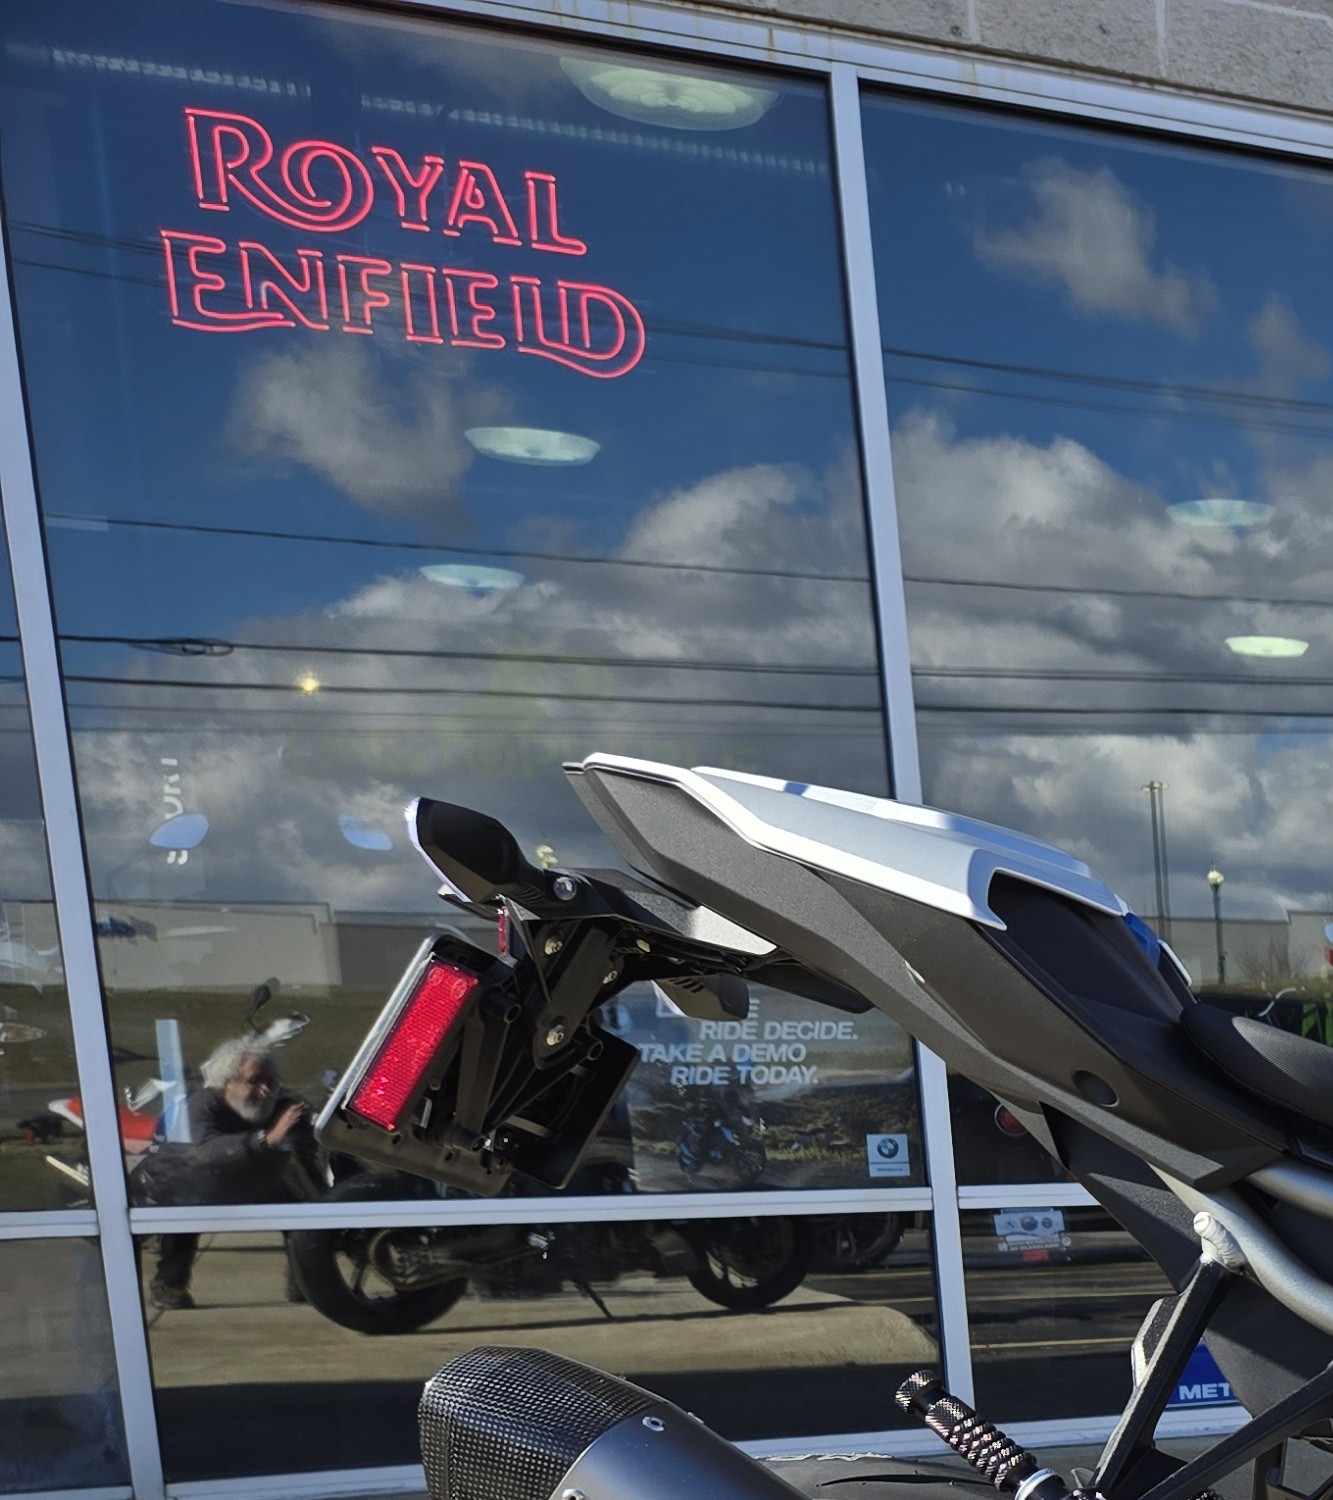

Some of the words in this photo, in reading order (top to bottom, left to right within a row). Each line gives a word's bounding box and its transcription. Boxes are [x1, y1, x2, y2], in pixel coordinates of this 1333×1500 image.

[185, 107, 587, 256] ROYAL
[160, 229, 646, 379] ENFIELD
[701, 1021, 758, 1041] RIDE
[764, 1021, 858, 1041] DECIDE.
[640, 1043, 703, 1063] TAKE
[706, 1043, 726, 1063] A
[731, 1043, 807, 1063] DEMO
[670, 1065, 730, 1085] RIDE
[737, 1065, 819, 1085] TODAY.
